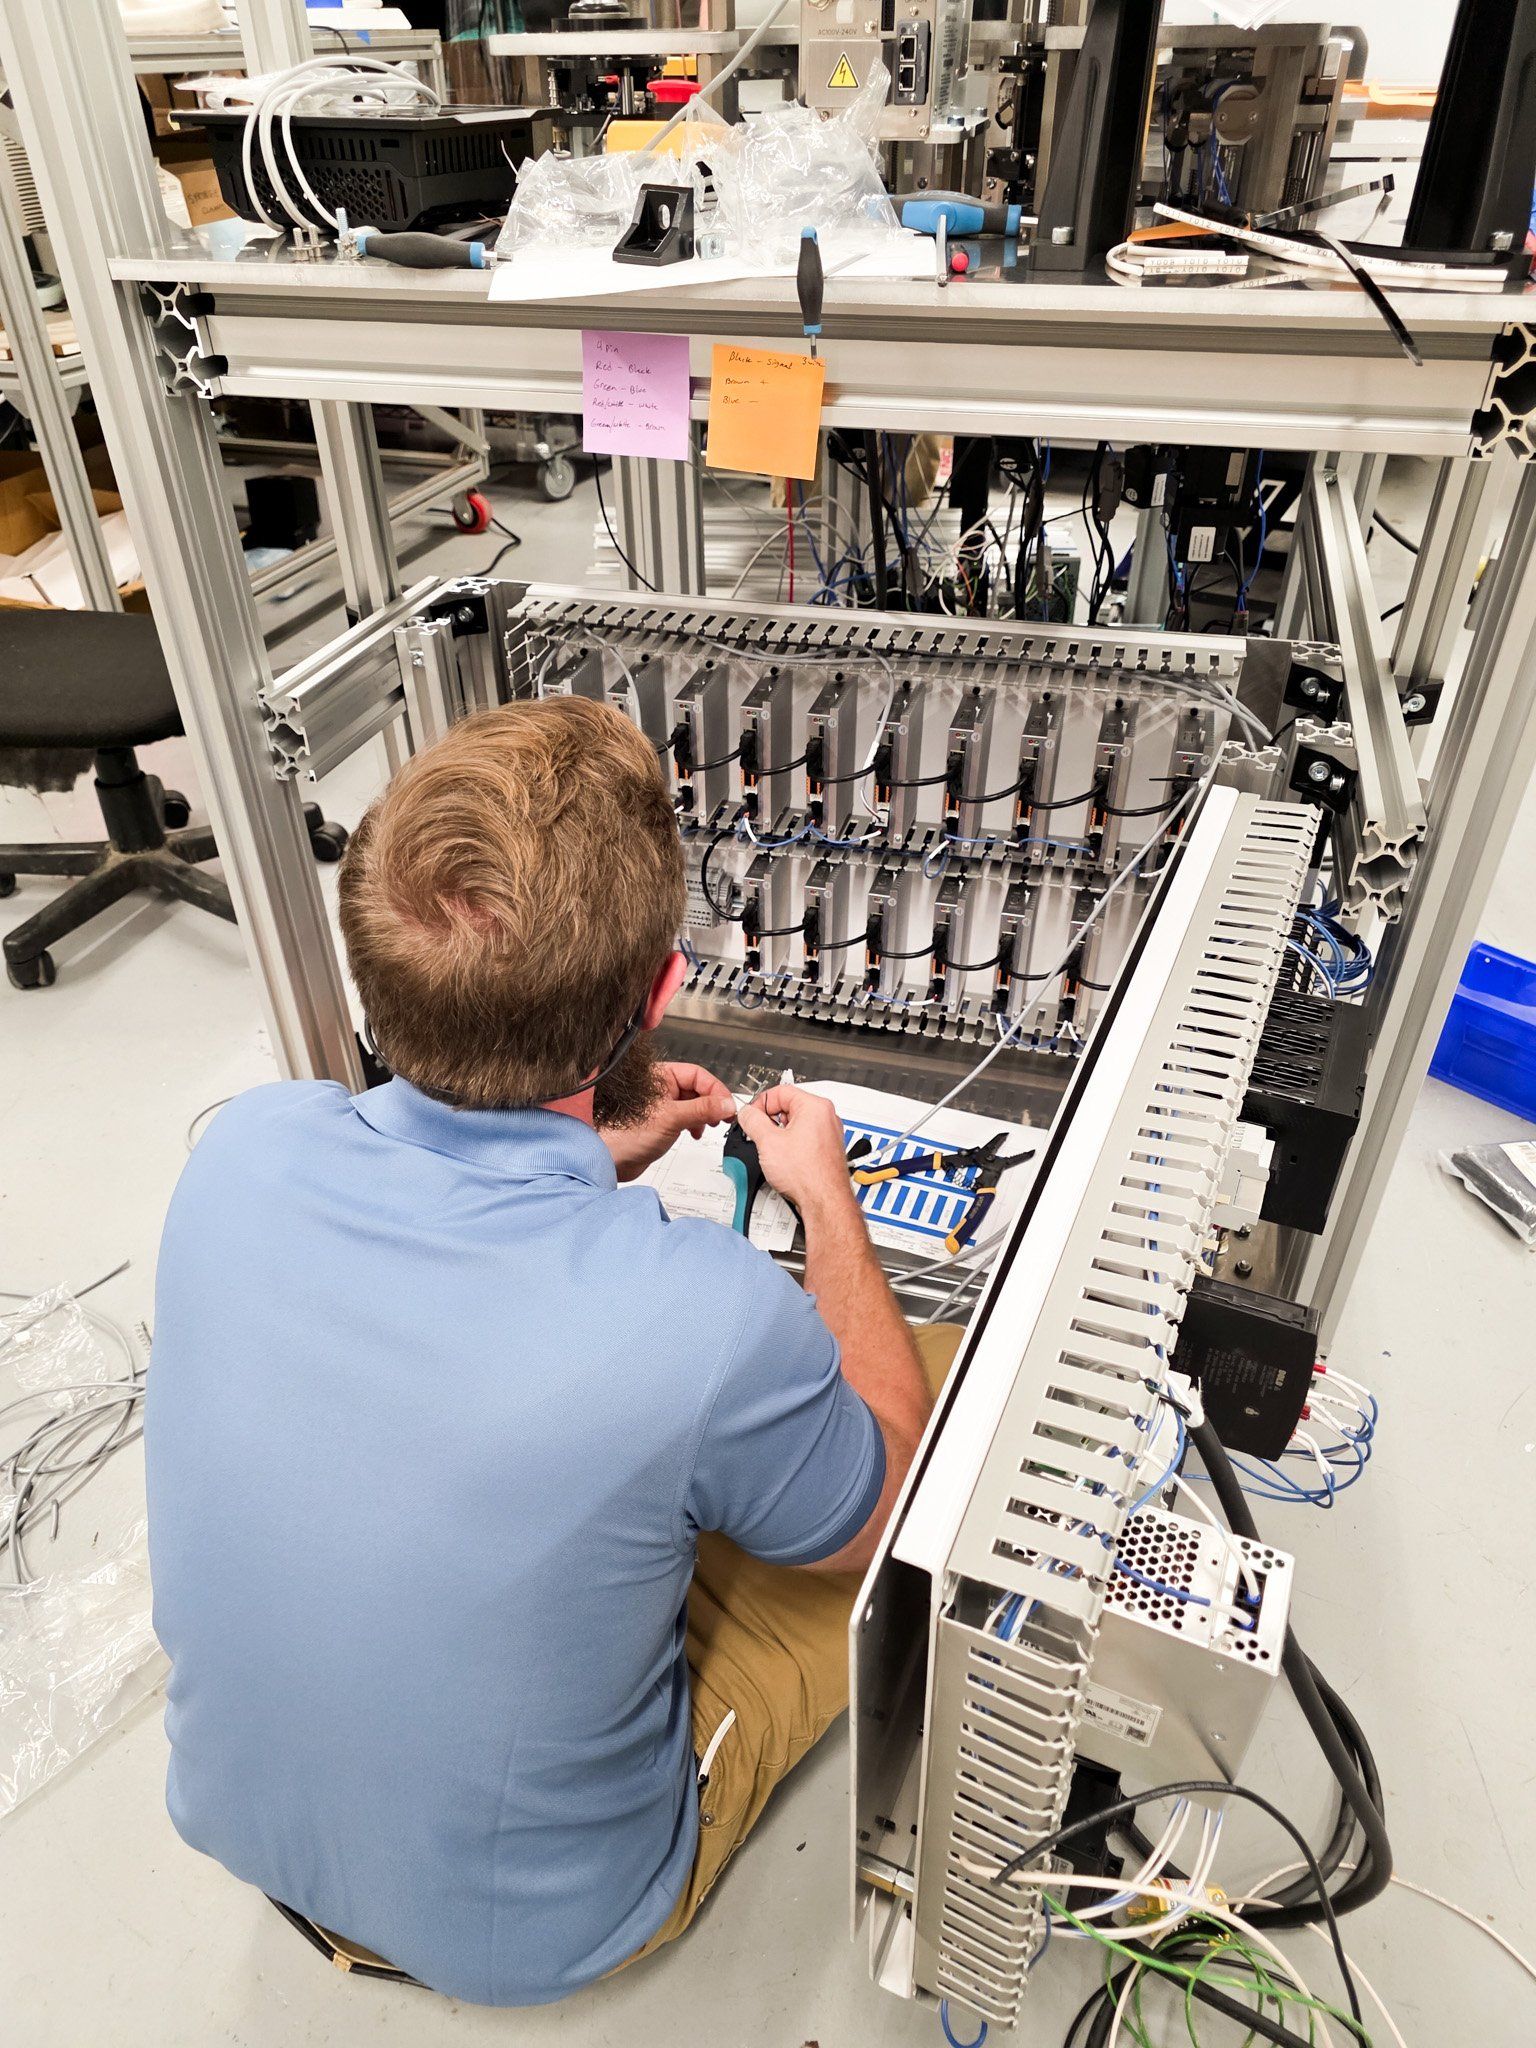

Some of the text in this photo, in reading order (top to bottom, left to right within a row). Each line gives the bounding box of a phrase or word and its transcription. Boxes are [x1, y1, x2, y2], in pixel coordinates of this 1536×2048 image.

[728, 350, 753, 363] Black
[628, 363, 652, 375] Black
[593, 378, 617, 391] Green
[629, 385, 647, 394] Blue
[725, 377, 751, 385] Brown
[722, 395, 740, 404] Blue
